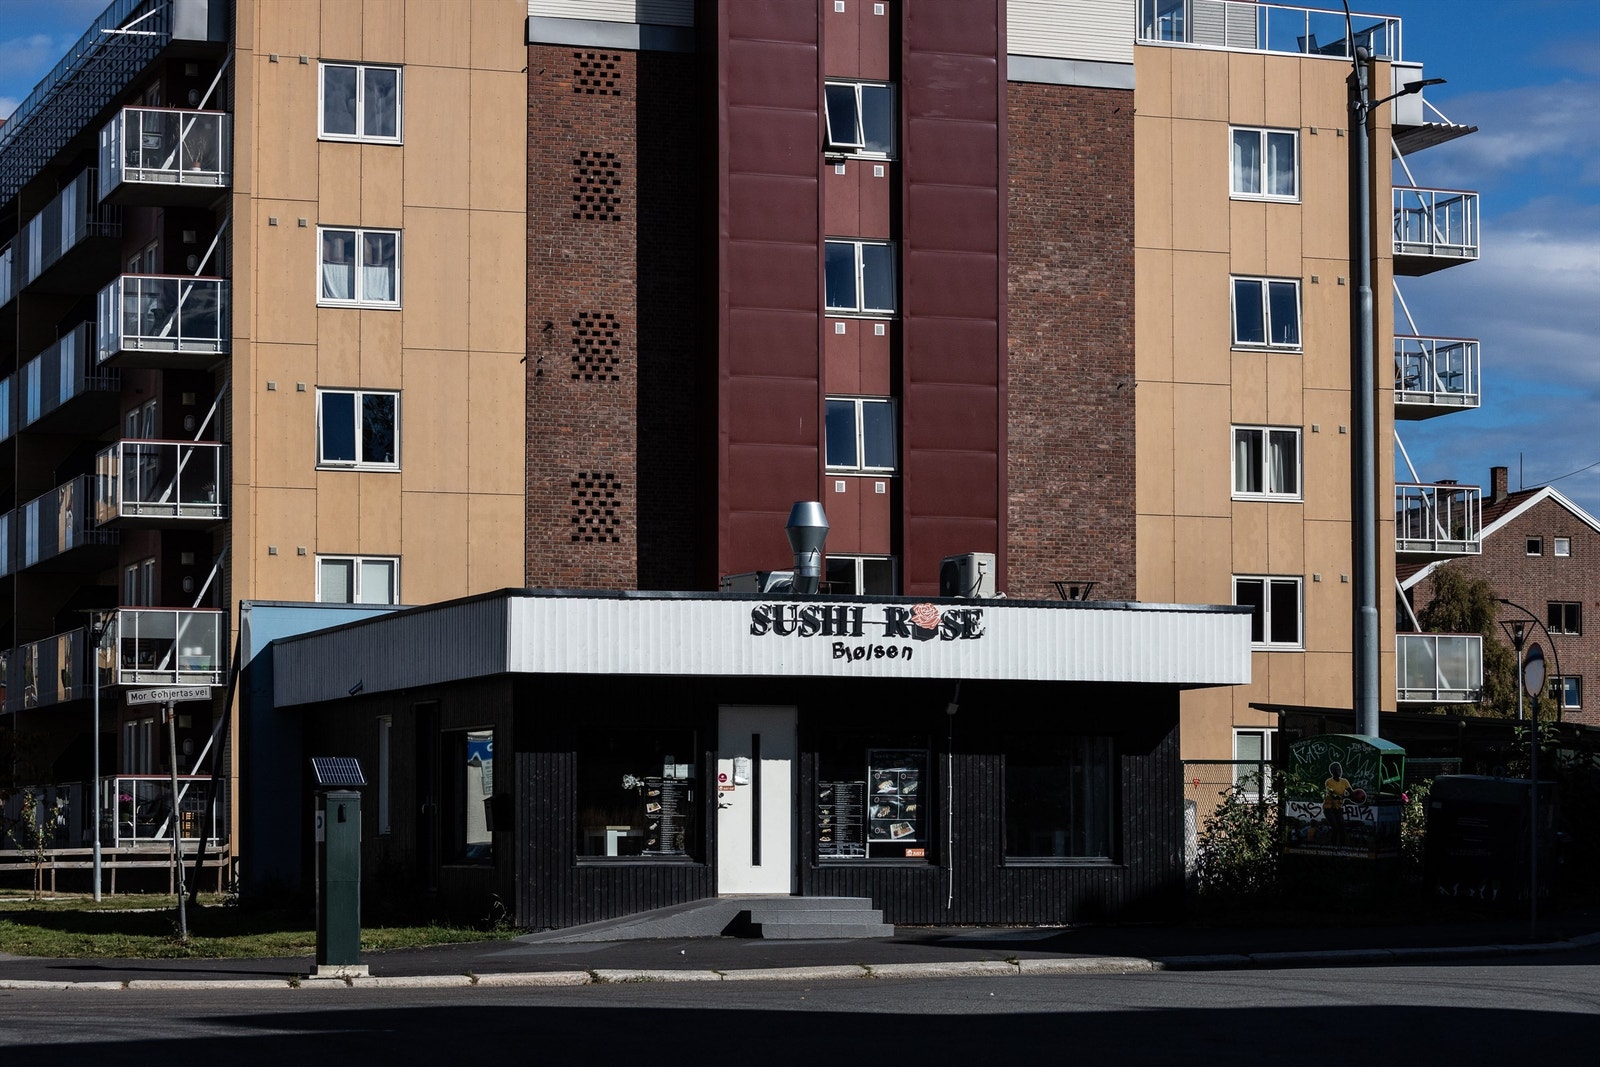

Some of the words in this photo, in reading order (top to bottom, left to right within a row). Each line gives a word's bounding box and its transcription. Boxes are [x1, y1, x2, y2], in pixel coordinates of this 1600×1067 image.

[750, 603, 865, 637] SUSHI
[832, 641, 913, 663] Bjølsen
[131, 692, 147, 701] Mor
